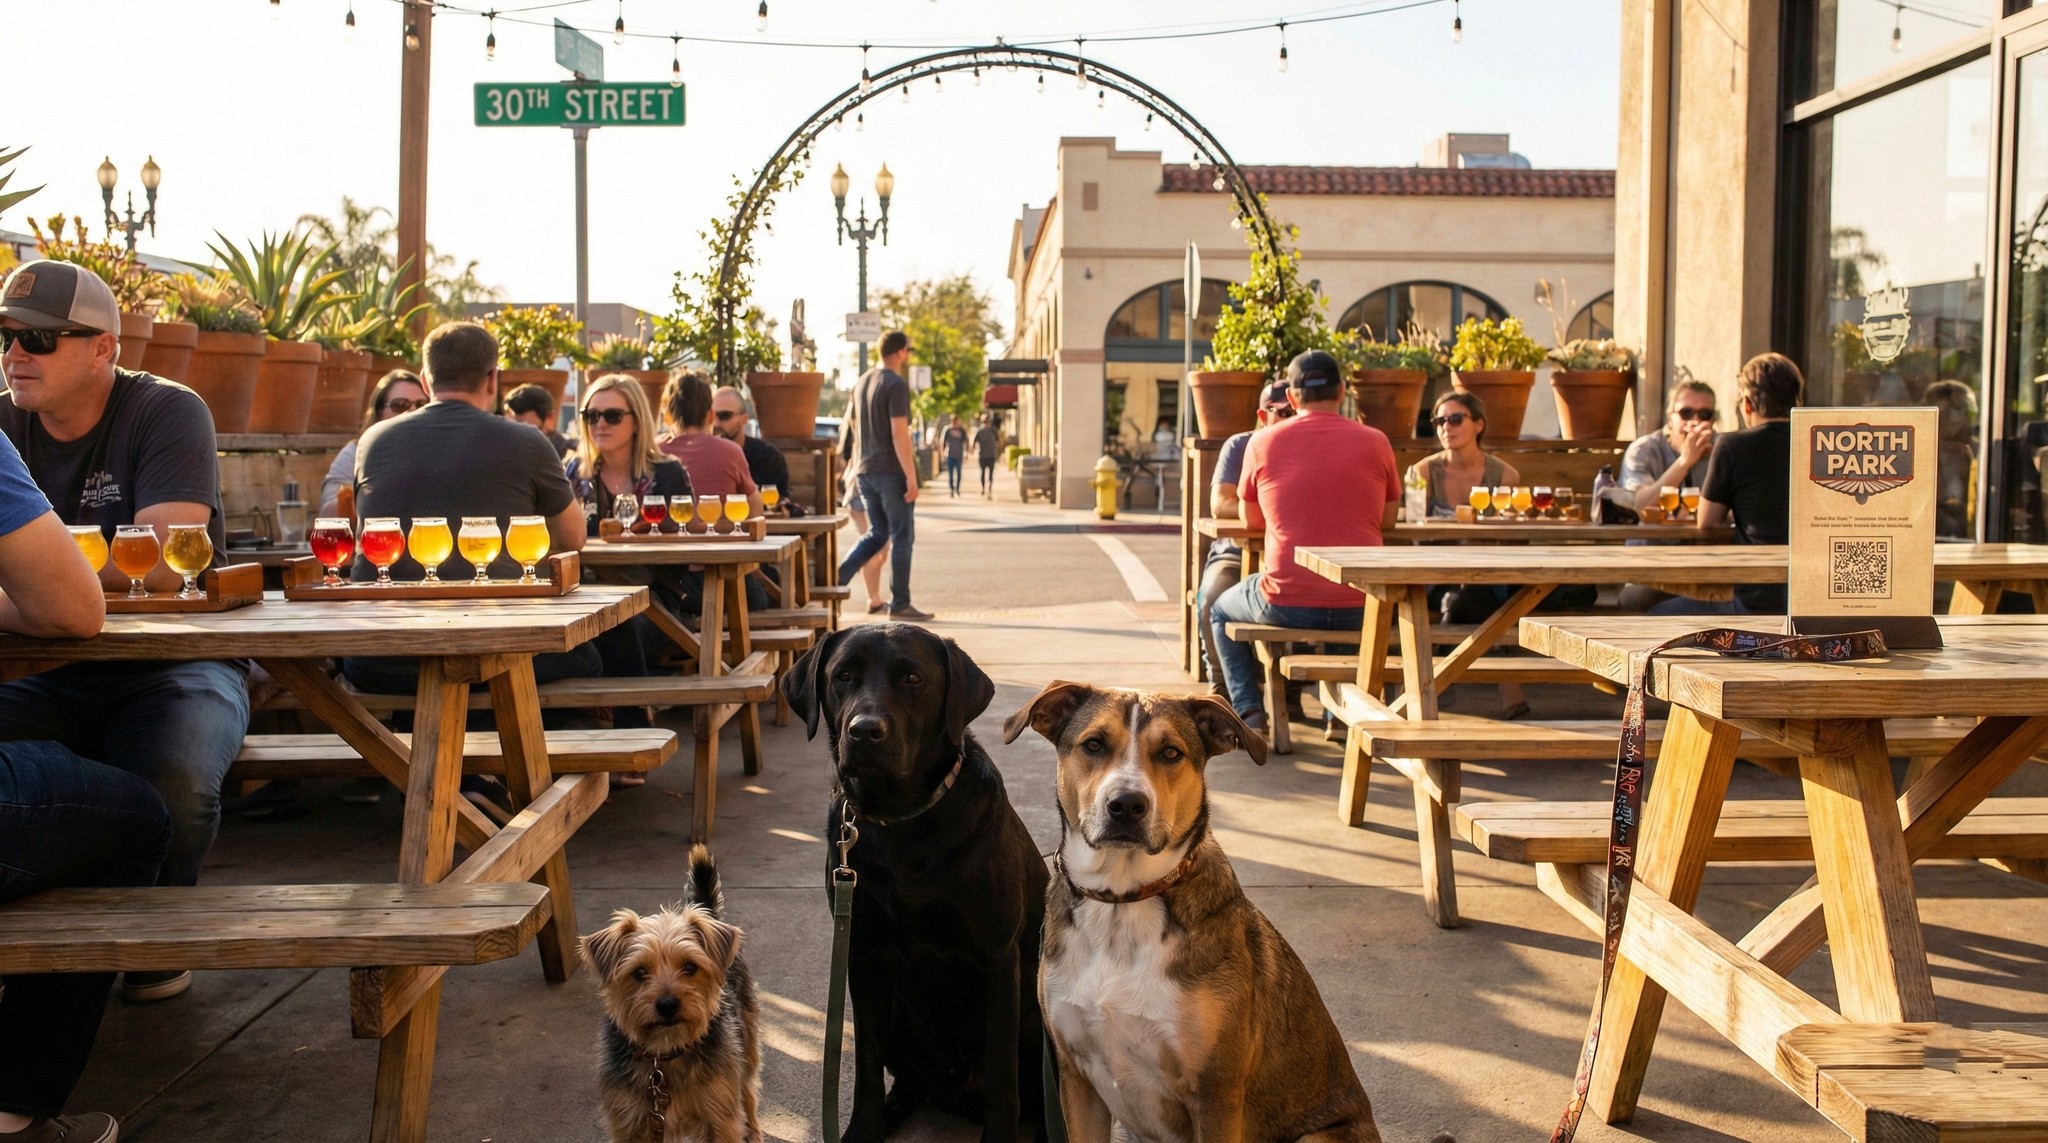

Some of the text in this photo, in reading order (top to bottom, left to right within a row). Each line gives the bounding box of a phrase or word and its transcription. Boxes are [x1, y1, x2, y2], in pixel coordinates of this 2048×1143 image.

[486, 88, 674, 121] 30TH STREET
[1816, 431, 1908, 452] NORTH
[1827, 454, 1898, 475] PARK
